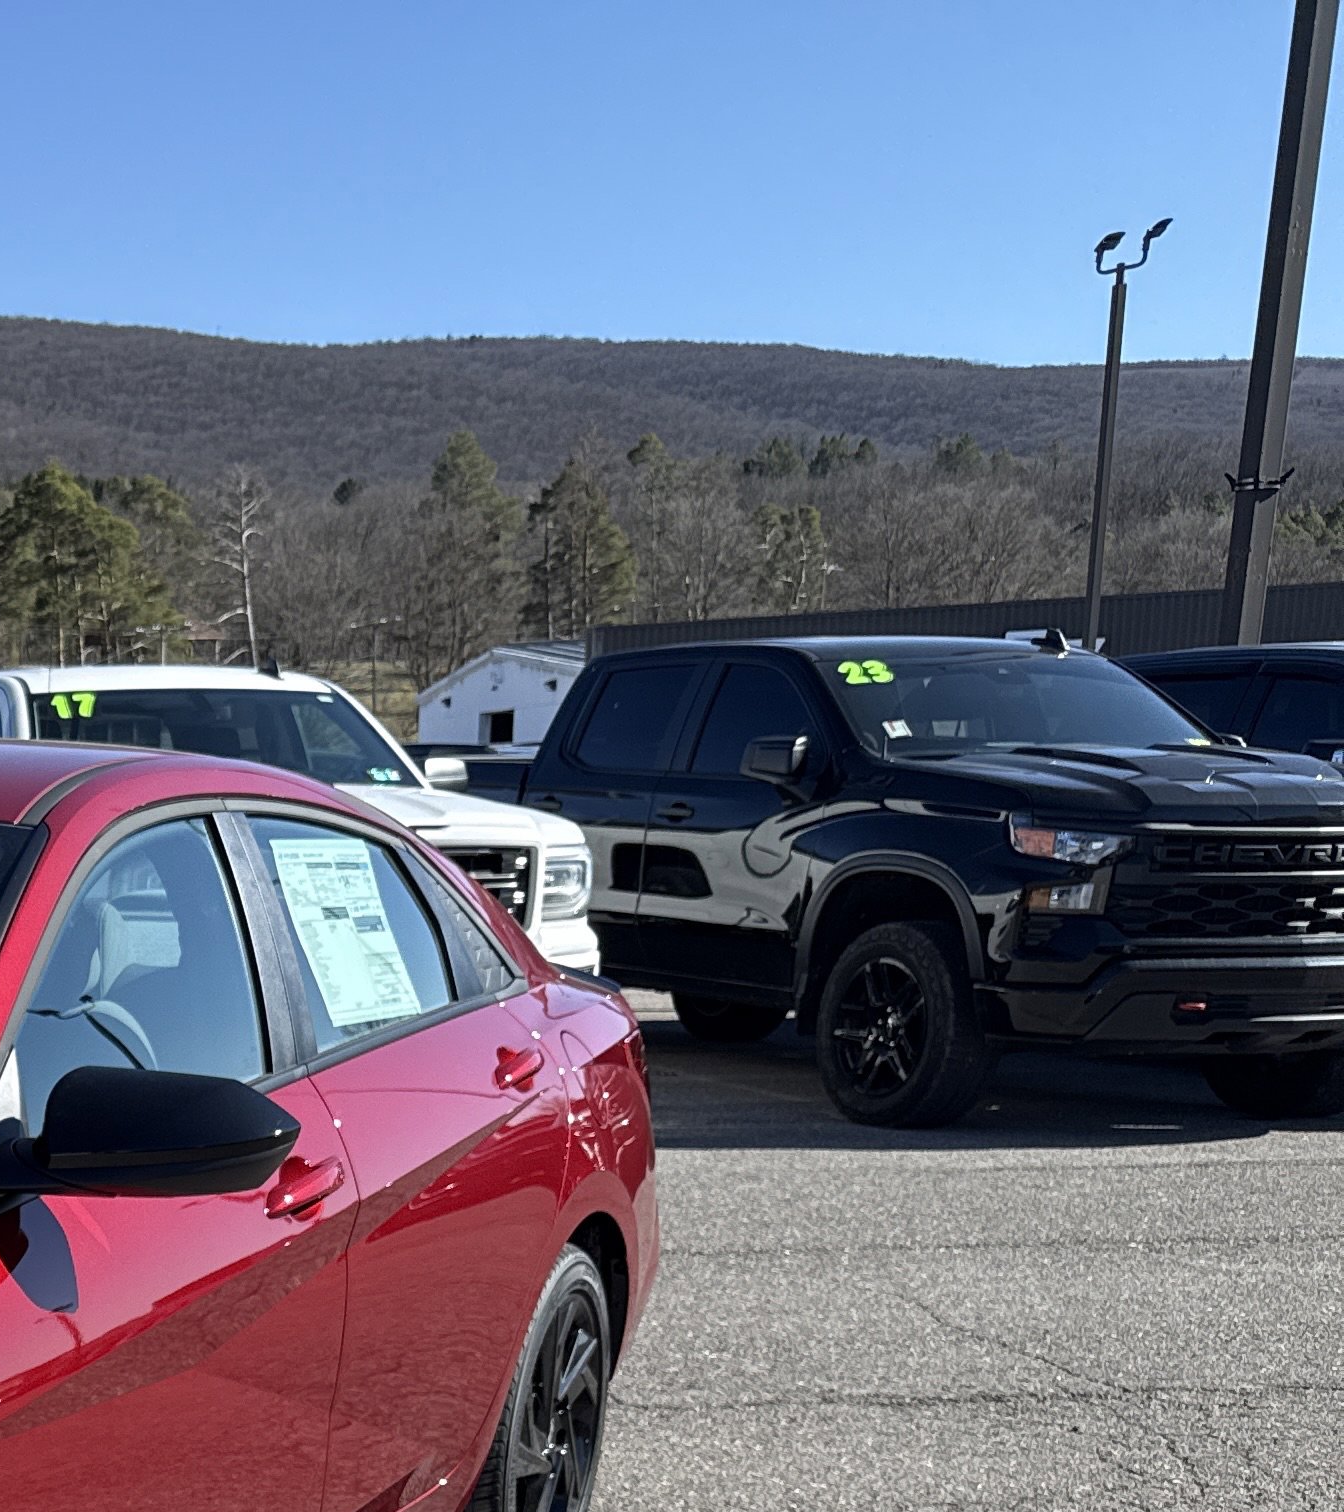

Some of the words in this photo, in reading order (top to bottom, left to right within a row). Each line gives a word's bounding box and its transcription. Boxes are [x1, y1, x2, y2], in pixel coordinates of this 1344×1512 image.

[837, 660, 894, 685] 23
[50, 693, 96, 719] 17
[1154, 843, 1344, 864] CHEVR
